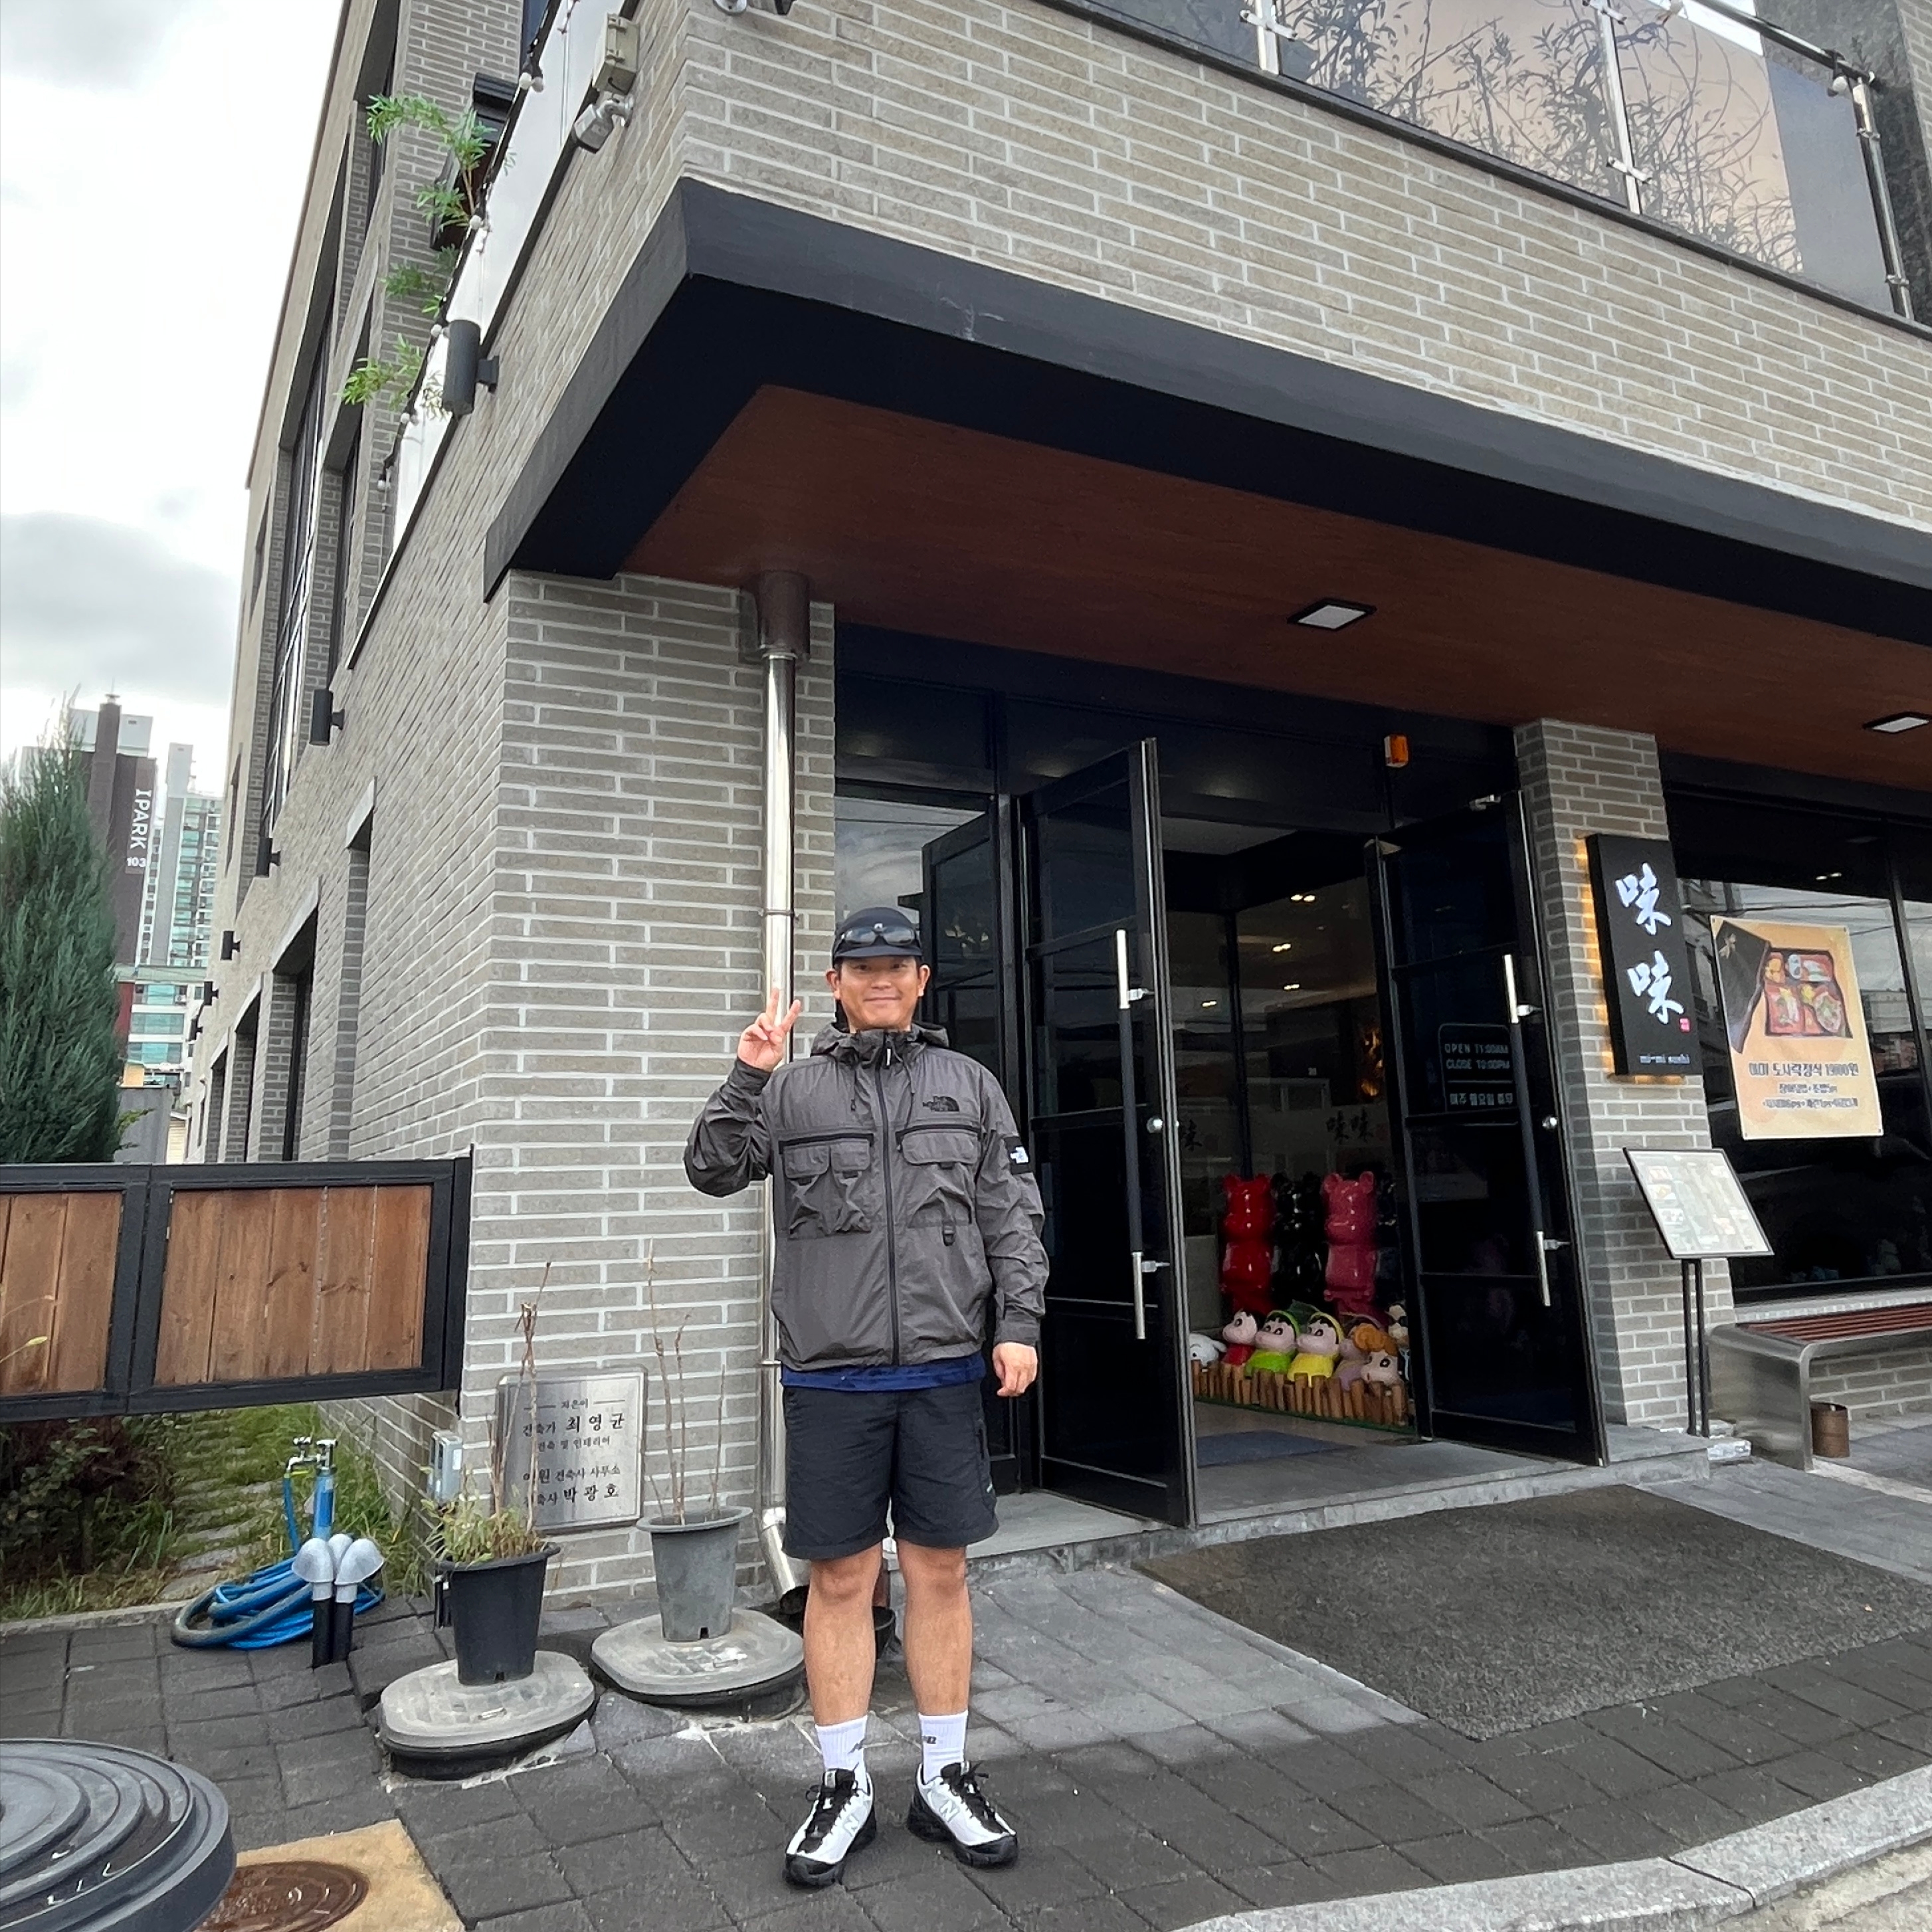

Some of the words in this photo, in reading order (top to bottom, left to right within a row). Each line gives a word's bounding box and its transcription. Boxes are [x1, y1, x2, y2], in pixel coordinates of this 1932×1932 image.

[130, 789, 152, 849] IPARK
[127, 857, 146, 868] 103
[1445, 1044, 1470, 1054] OPEN
[1446, 1059, 1472, 1069] CLOSE
[561, 1398, 589, 1409] 지은이
[573, 1436, 611, 1449] 인테리어
[555, 1468, 585, 1482] 건축사
[590, 1464, 621, 1478] 사무소
